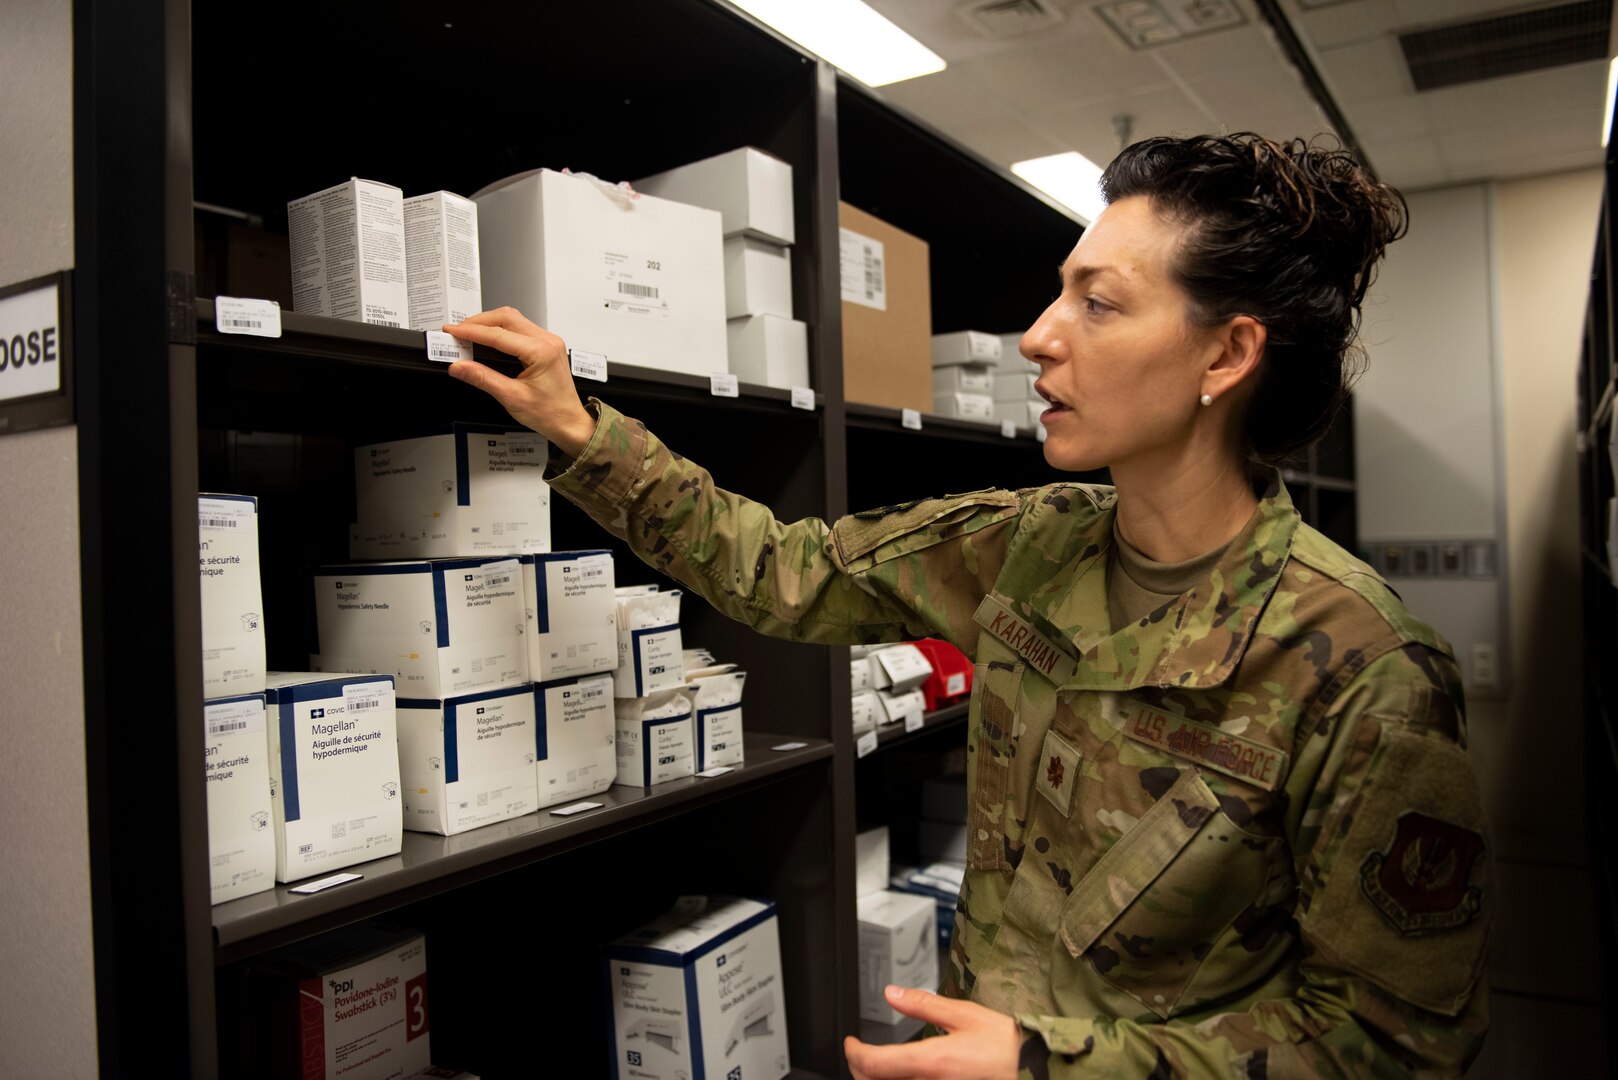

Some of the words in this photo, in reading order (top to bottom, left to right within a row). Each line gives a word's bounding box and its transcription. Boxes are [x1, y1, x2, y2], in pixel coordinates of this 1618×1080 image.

[647, 260, 661, 271] 202
[207, 555, 240, 565] sécurité
[374, 602, 389, 610] Needle
[989, 611, 1061, 675] KARAHAN
[312, 737, 342, 750] Aiguille
[343, 735, 353, 745] de
[354, 731, 382, 743] sécurité
[312, 743, 369, 760] hypodermique
[1174, 723, 1212, 758] AIR
[1216, 735, 1276, 783] FORCE
[216, 755, 250, 770] sécurité
[389, 789, 396, 797] 50
[259, 820, 267, 828] 50
[300, 845, 311, 853] REF
[334, 979, 354, 995] PDI
[334, 975, 400, 1009] Povidone-Iodine
[334, 997, 377, 1023] Swabstick
[379, 987, 398, 1007] (3's)
[409, 985, 425, 1032] 3
[627, 1052, 641, 1065] 35
